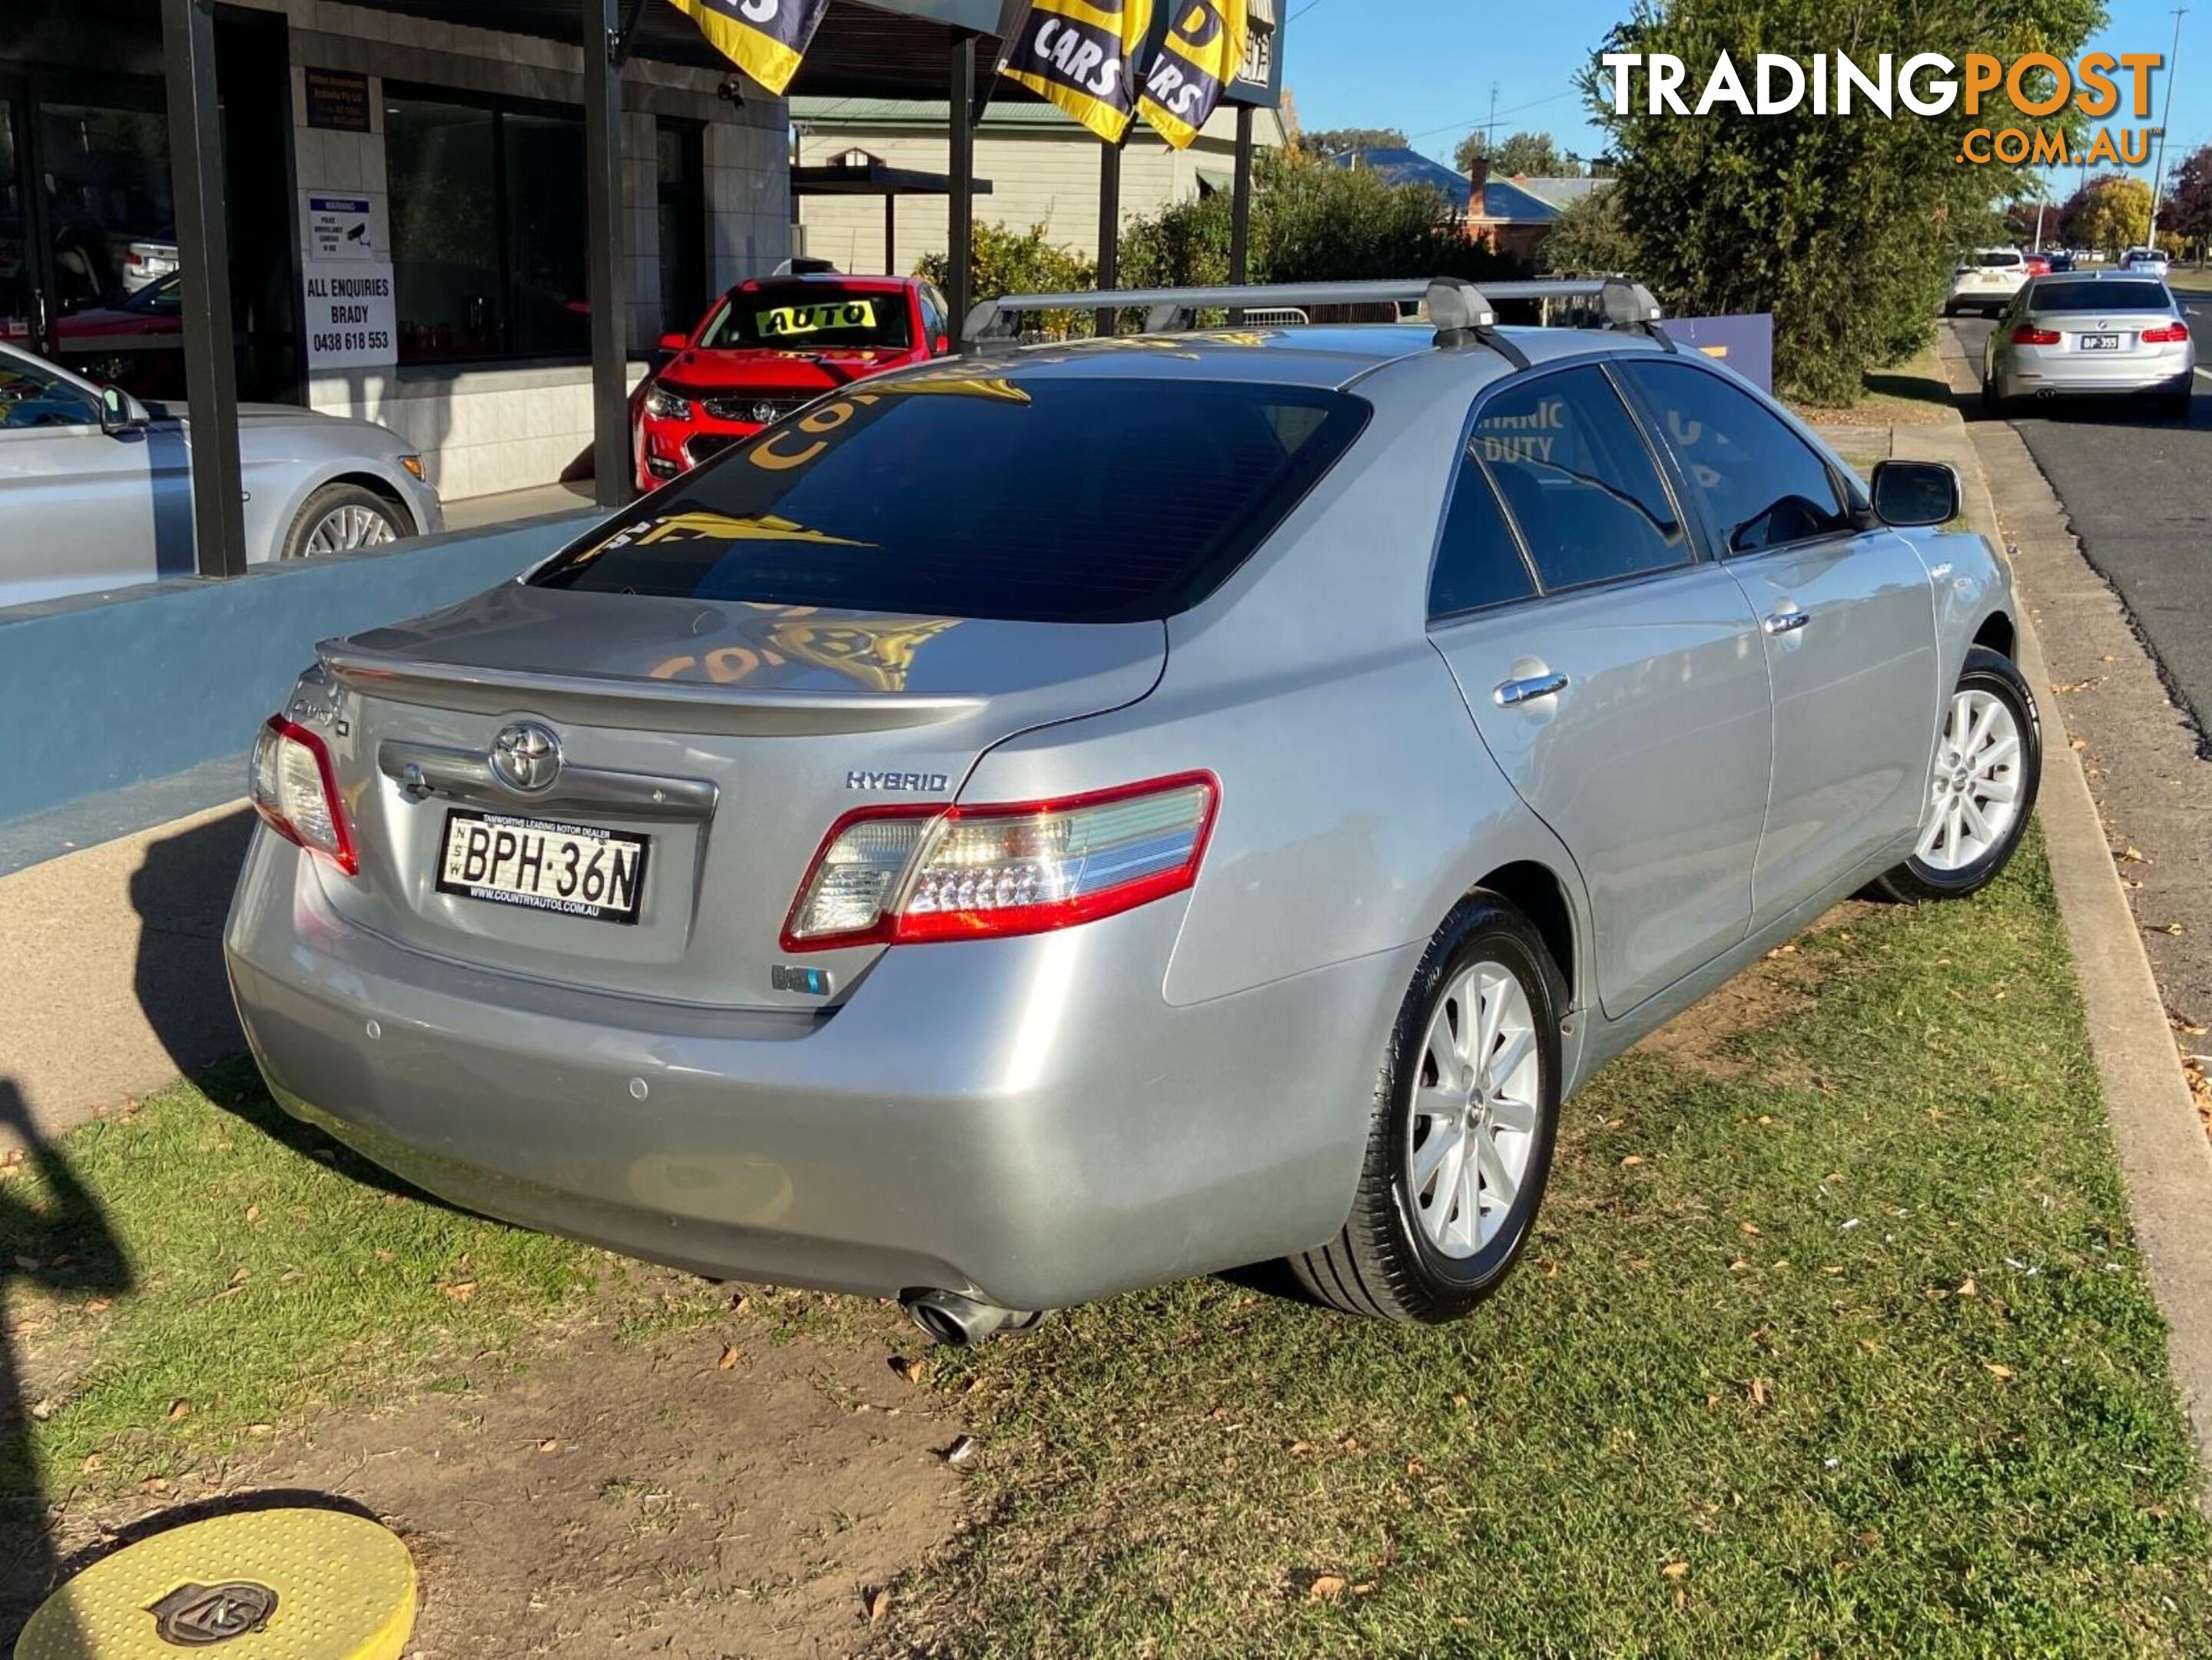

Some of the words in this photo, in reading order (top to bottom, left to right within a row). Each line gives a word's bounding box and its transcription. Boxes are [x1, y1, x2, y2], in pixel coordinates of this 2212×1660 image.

[1033, 18, 1120, 96] CARS
[307, 278, 328, 297] ALL
[331, 278, 389, 298] ENQUIRIES
[331, 305, 369, 324] BRADY
[766, 304, 866, 334] AUTO
[313, 332, 342, 352] 0438
[345, 332, 365, 350] 618
[369, 331, 389, 349] 553
[1484, 436, 1554, 463] DUTY
[847, 771, 948, 792] HYBRID
[483, 814, 525, 828] TAMWORTHS
[526, 821, 555, 832] LEADING
[582, 828, 610, 839] DEALER
